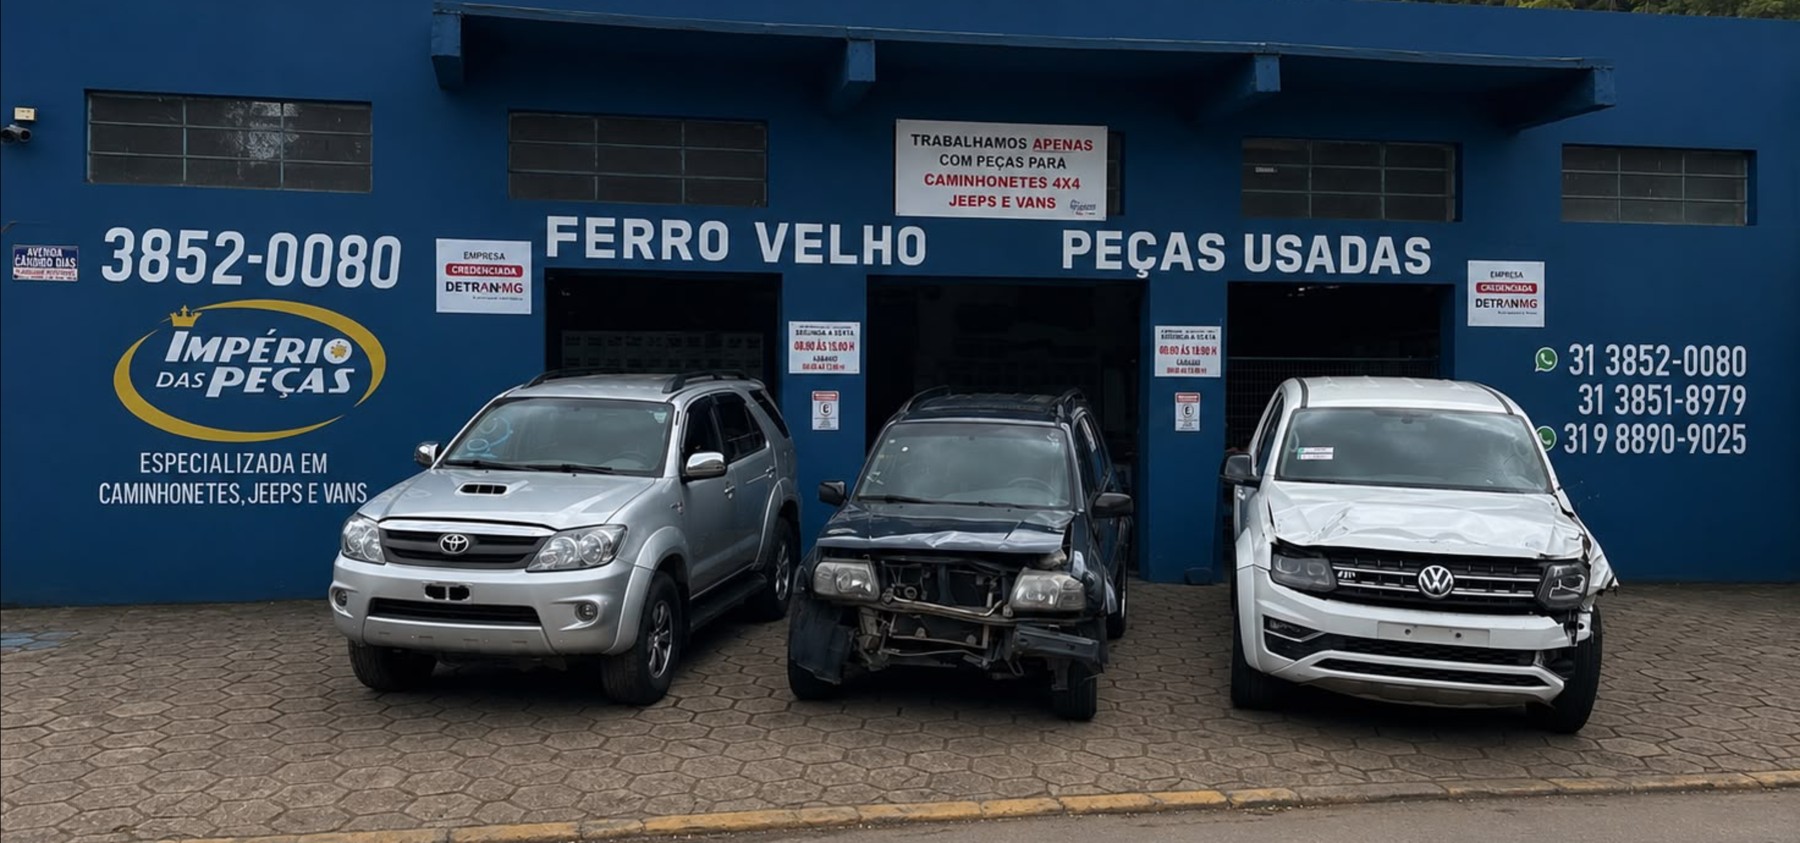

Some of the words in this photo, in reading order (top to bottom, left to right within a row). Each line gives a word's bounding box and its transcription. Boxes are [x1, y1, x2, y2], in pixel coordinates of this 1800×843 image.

[911, 134, 1027, 149] TRABALHAMOS
[1032, 138, 1093, 151] APENAS
[939, 154, 972, 167] COM
[976, 155, 1024, 171] PEÇAS
[1029, 157, 1066, 169] PARA
[924, 173, 1047, 189] CAMINHONETES
[1052, 177, 1080, 190] 4X4
[949, 195, 997, 208] JEEPS
[1002, 196, 1011, 208] E
[1015, 197, 1056, 209] VANS
[546, 216, 729, 261] FERRO
[754, 222, 926, 266] VELHO
[1062, 230, 1225, 278] PEÇAS
[1244, 234, 1431, 275] USADAS
[55, 257, 76, 267] DIAS
[101, 227, 402, 289] 3852-0080
[165, 329, 352, 364] IMPÉRIO
[1568, 343, 1594, 376] 31
[1605, 344, 1747, 377] 3852-0080
[155, 372, 205, 388] DAS
[205, 366, 355, 398] PEÇAS
[1578, 383, 1603, 415] 31
[1614, 384, 1747, 416] 3851-8979
[1615, 423, 1746, 454] 8890-9025
[140, 453, 295, 474] ESPECIALIZADA
[301, 453, 327, 474] EM
[99, 482, 245, 506] CAMINHONETES,
[247, 483, 303, 504] JEEPS
[308, 483, 318, 504] E
[323, 483, 368, 504] VANS
